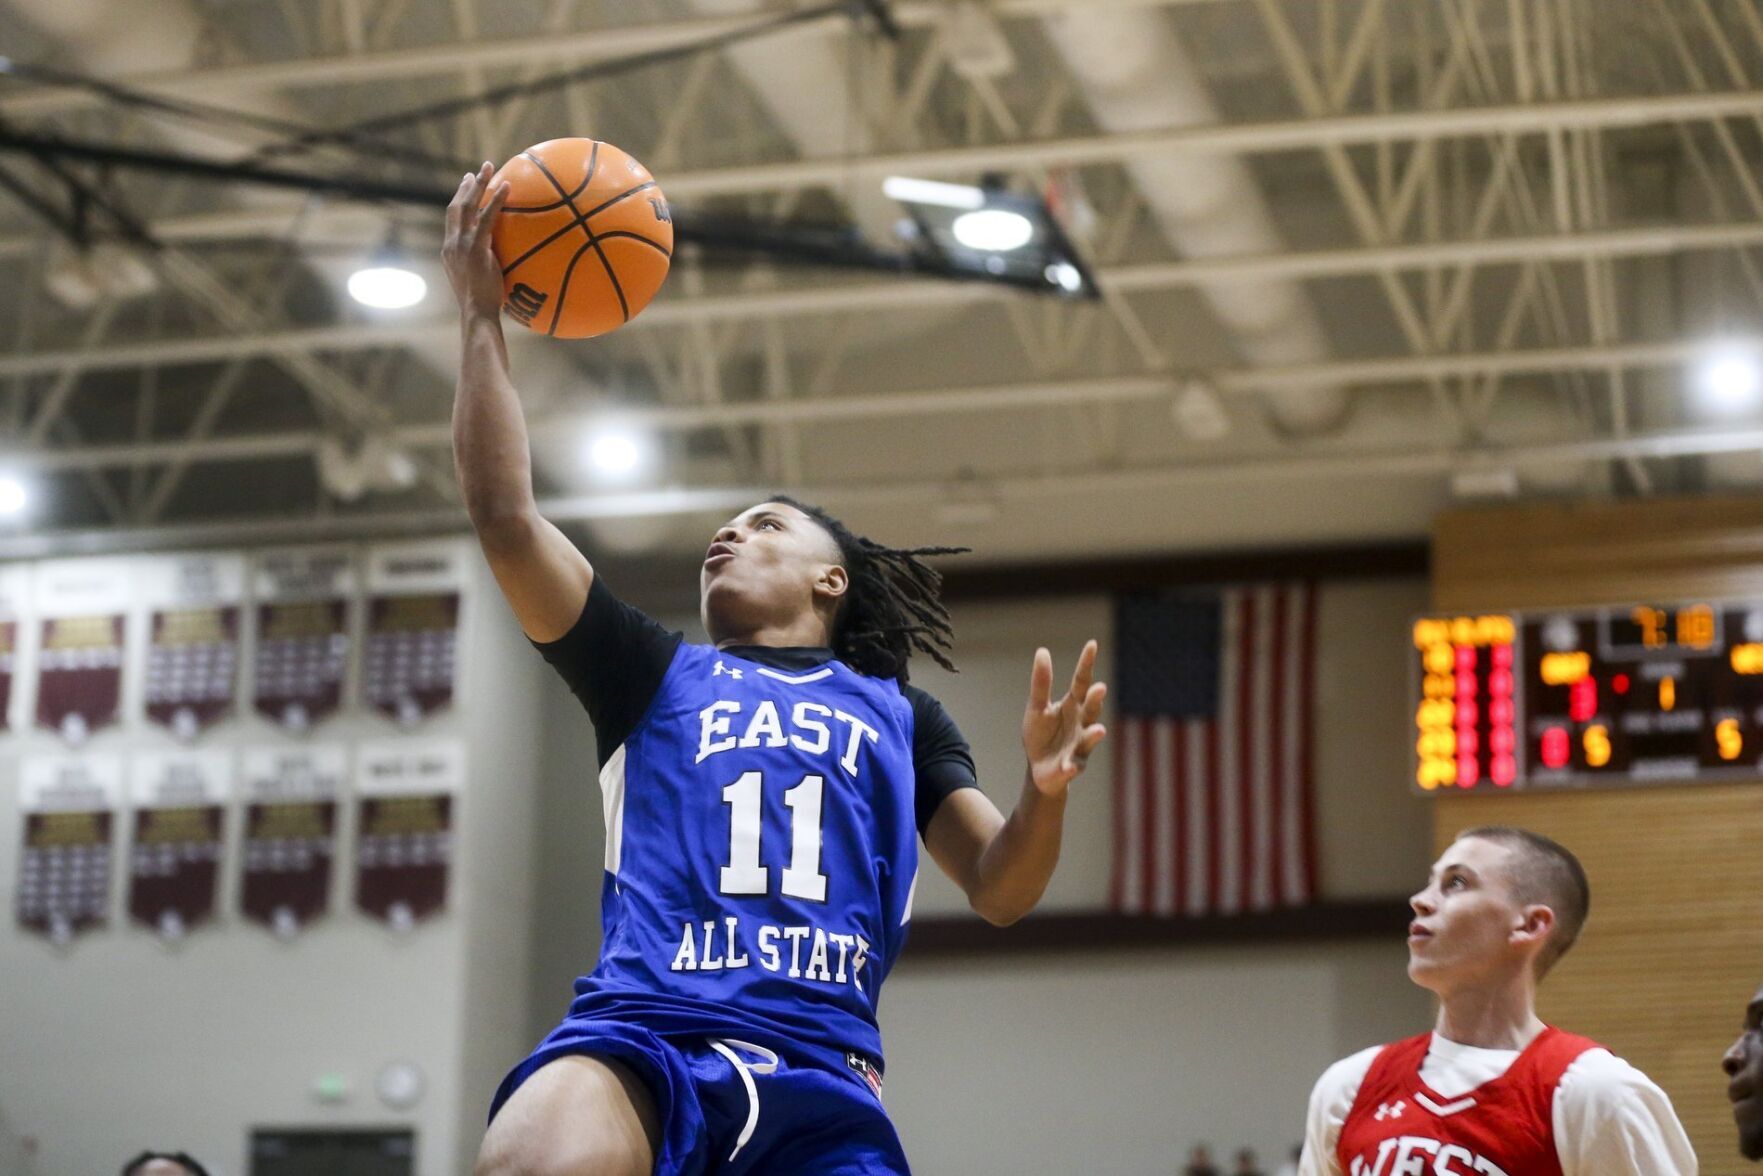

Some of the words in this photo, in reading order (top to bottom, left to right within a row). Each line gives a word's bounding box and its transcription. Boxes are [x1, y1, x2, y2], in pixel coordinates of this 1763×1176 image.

[695, 700, 880, 777] EAST
[719, 770, 828, 902] 11
[671, 917, 749, 972] ALL
[758, 925, 868, 992] STATE
